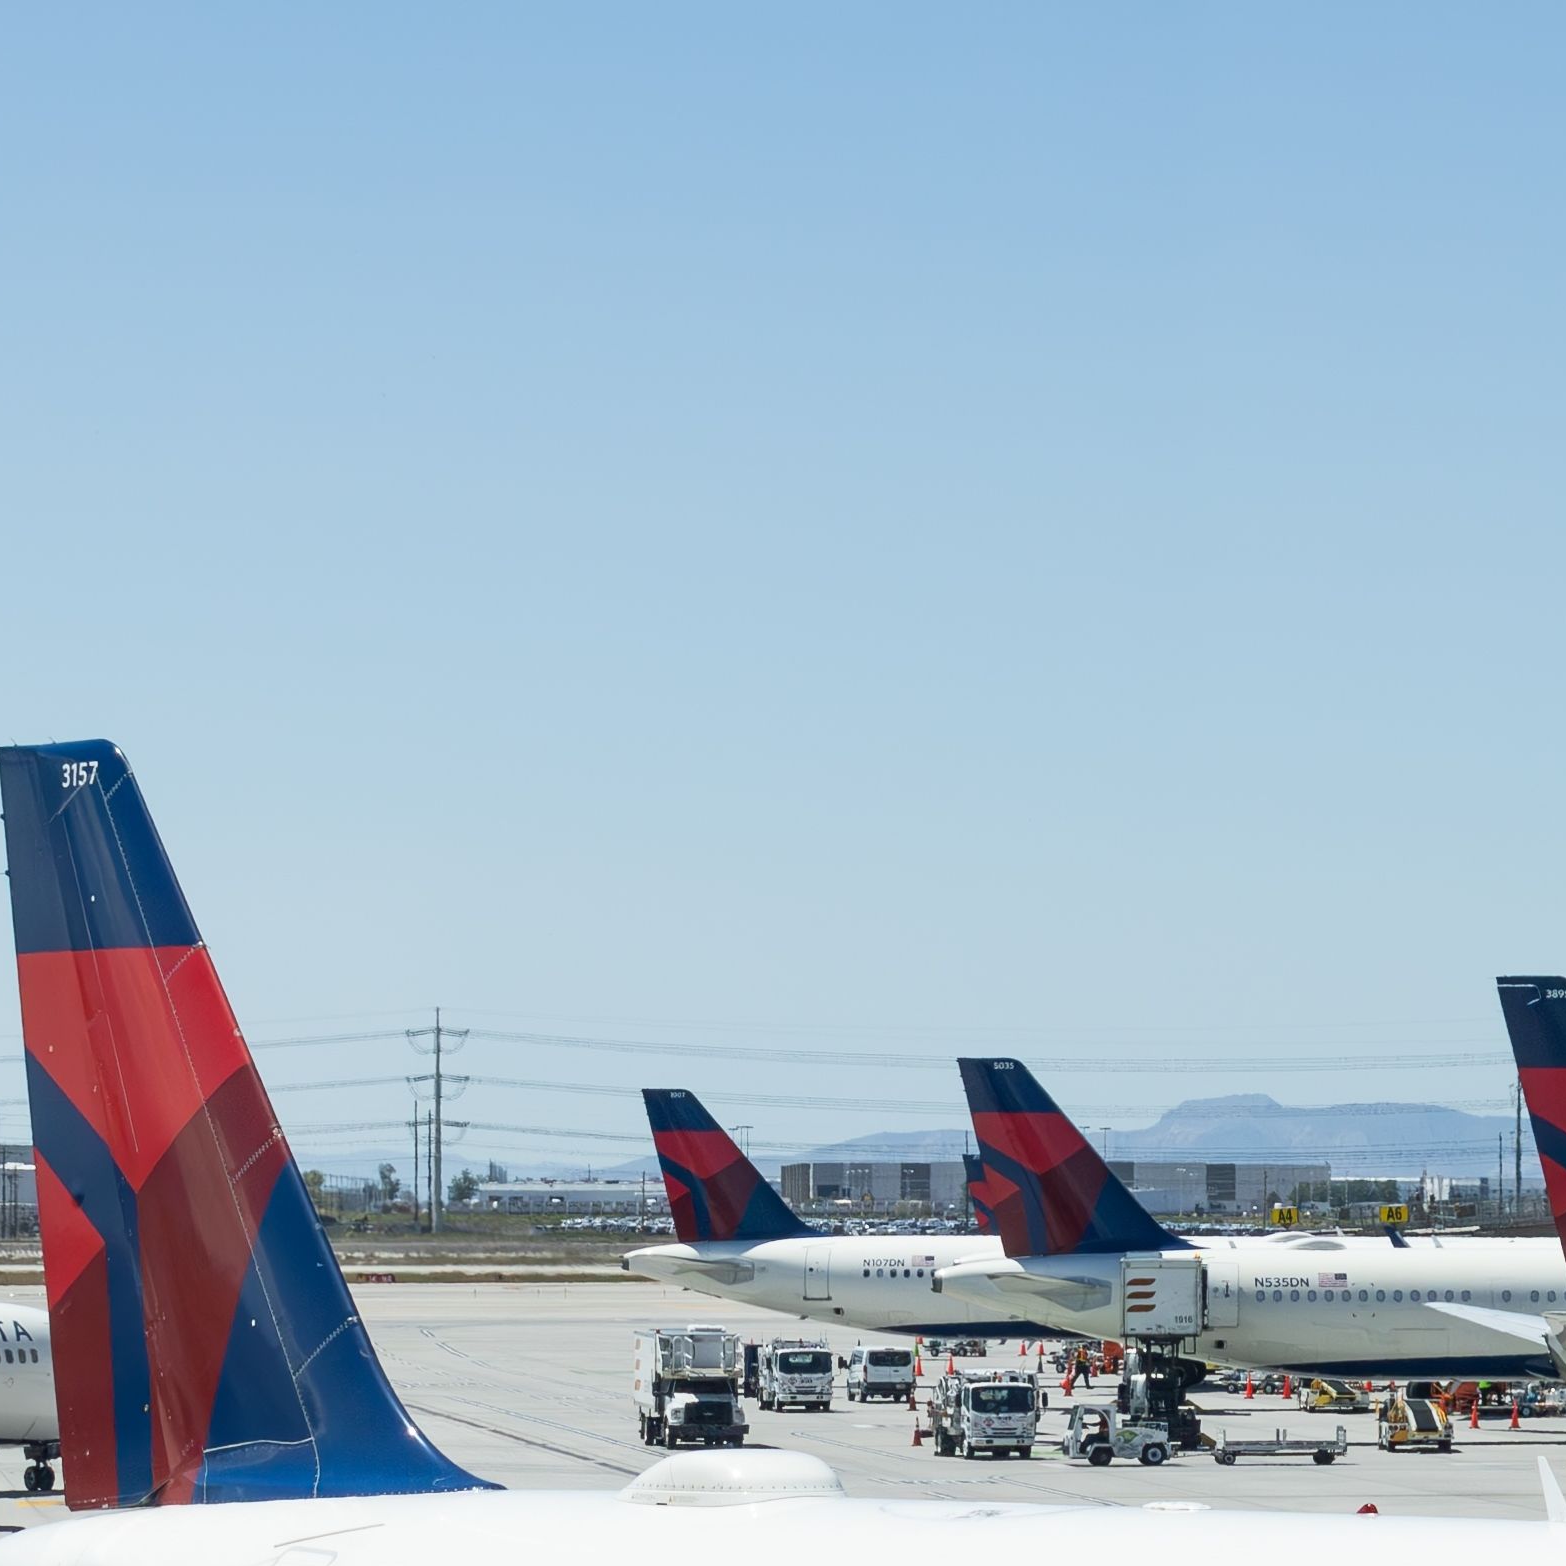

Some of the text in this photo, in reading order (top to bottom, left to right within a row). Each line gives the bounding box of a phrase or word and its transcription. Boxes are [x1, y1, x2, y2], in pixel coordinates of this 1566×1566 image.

[62, 761, 99, 788] 3157
[993, 1062, 1015, 1070] 5035
[1277, 1208, 1292, 1224] A4
[1386, 1206, 1402, 1221] A6
[863, 1259, 905, 1267] N107DN
[1254, 1277, 1310, 1288] N535DN
